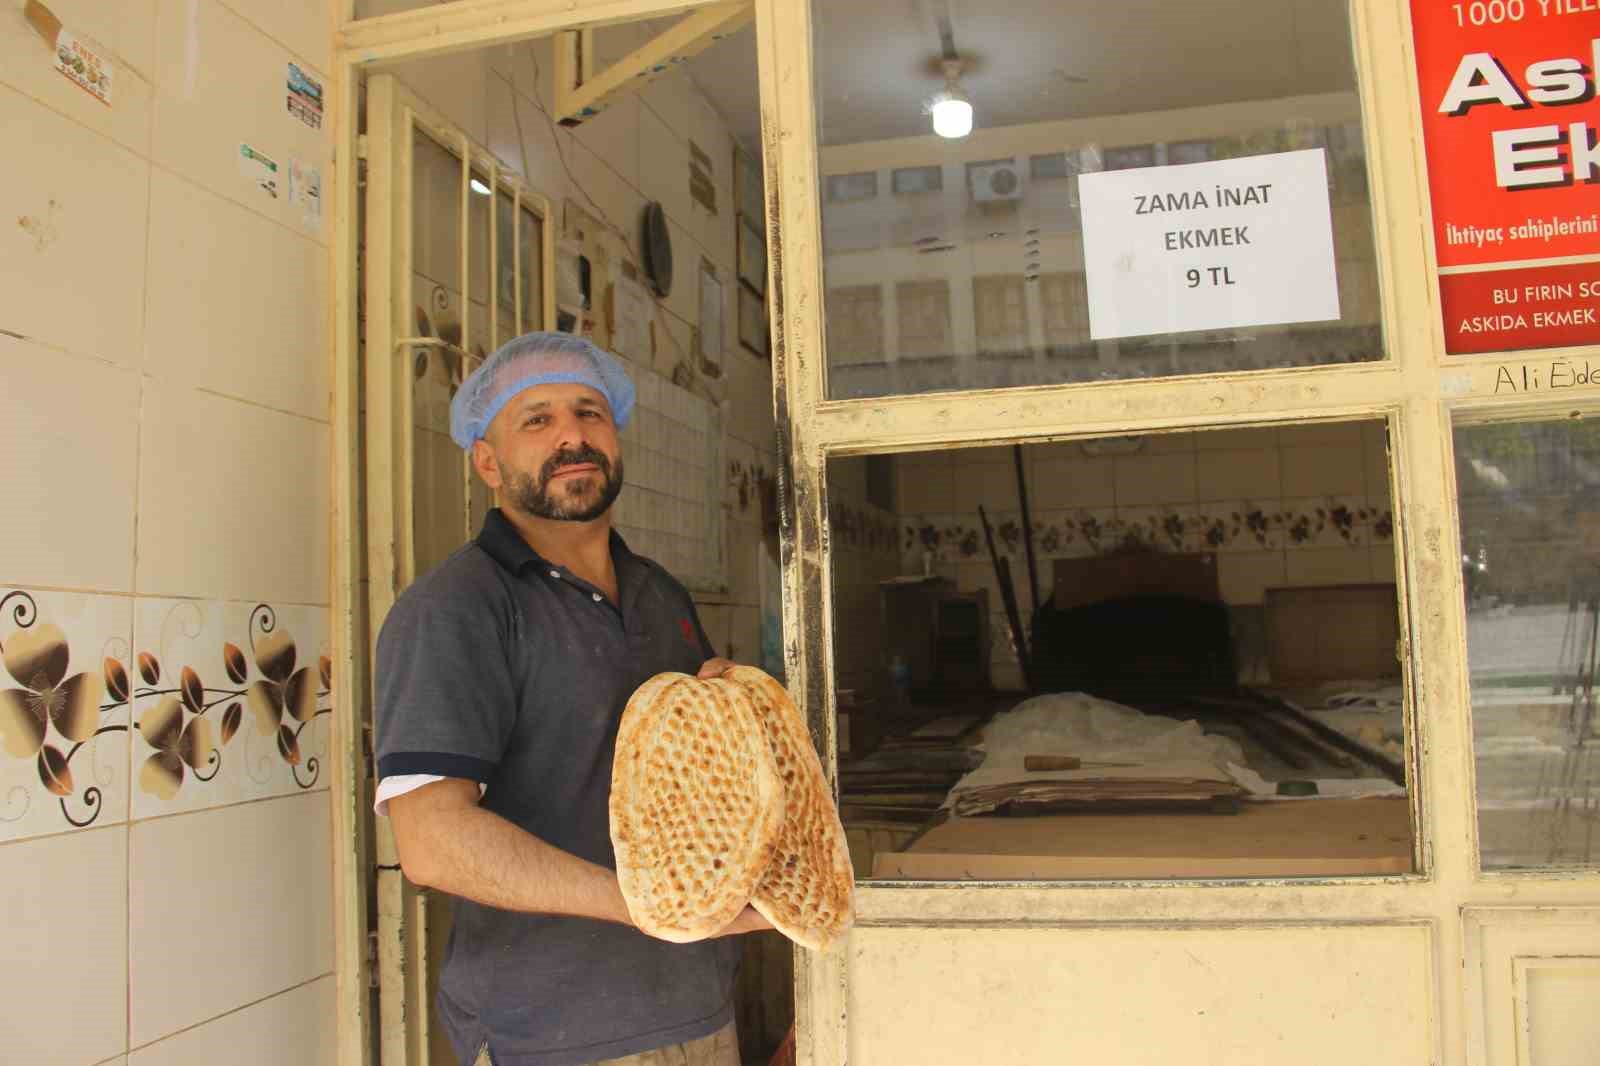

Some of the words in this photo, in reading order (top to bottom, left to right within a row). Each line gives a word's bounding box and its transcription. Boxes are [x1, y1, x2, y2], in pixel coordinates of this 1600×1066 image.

[1453, 0, 1524, 27] 1000
[1134, 192, 1209, 215] ZAMA
[1215, 184, 1272, 208] İNAT
[1164, 226, 1250, 250] EKMEK
[1446, 222, 1504, 248] İhtiyaç
[1509, 215, 1598, 242] sahiplerini
[1186, 269, 1201, 288] 9
[1208, 267, 1235, 286] TL
[1493, 289, 1518, 304] BU
[1525, 283, 1573, 303] FIRIN
[1459, 315, 1528, 333] ASKIDA
[1533, 308, 1596, 327] EKMEK
[1494, 366, 1539, 393] Ali
